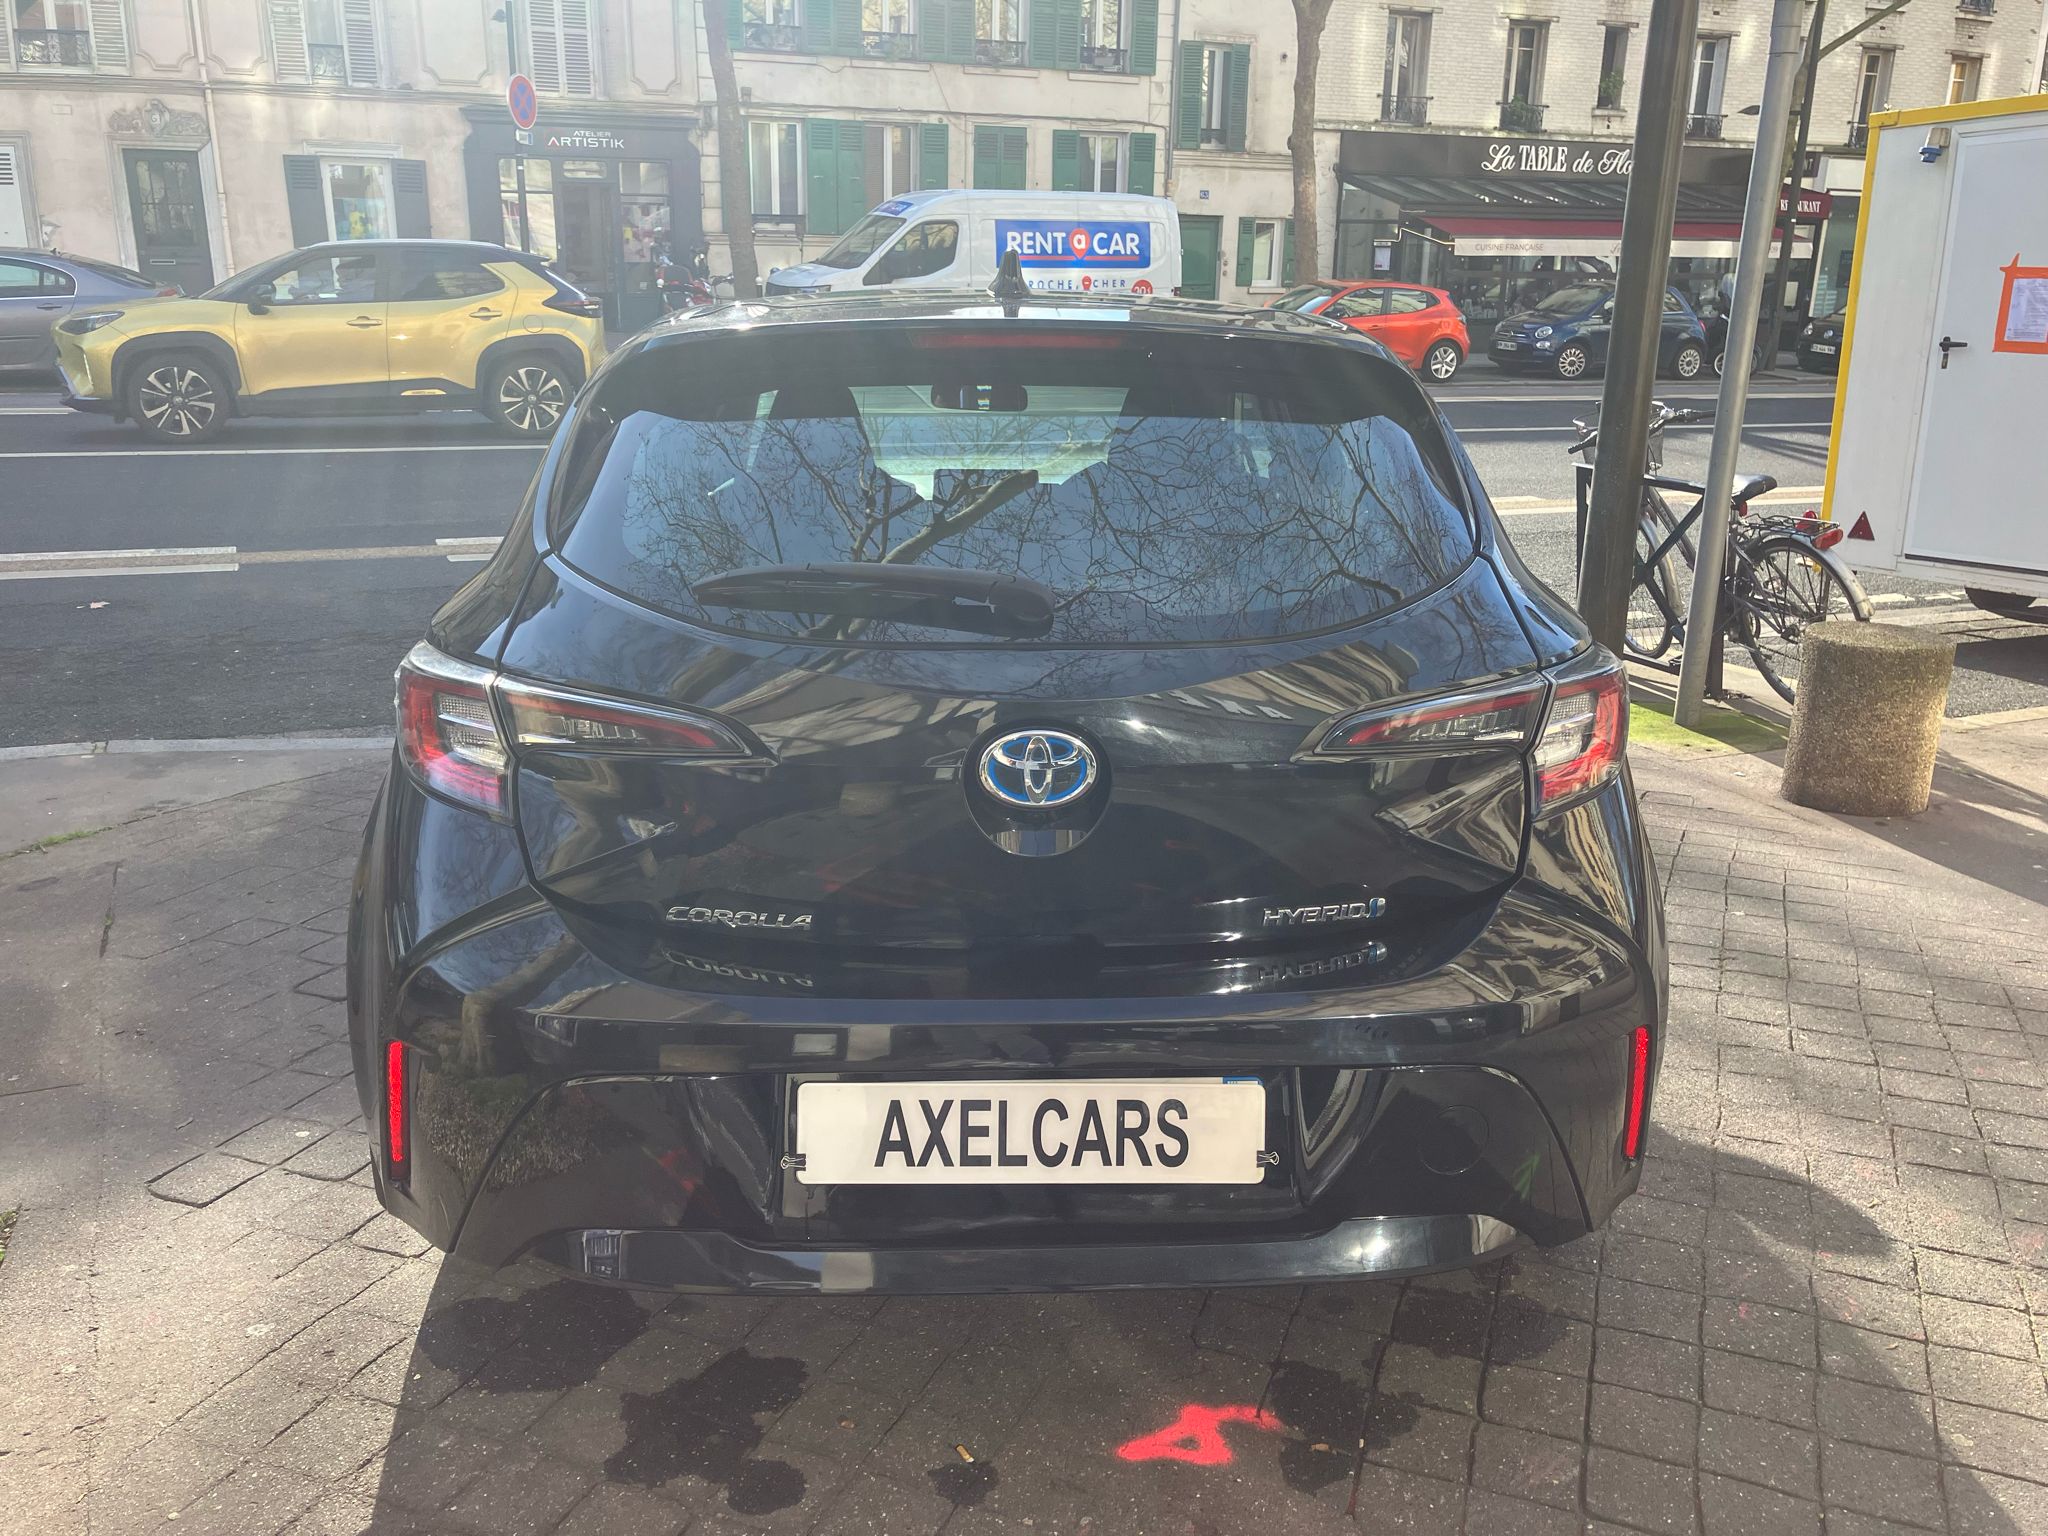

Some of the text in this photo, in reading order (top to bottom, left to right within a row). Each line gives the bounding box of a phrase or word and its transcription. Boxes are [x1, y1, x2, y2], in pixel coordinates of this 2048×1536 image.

[548, 137, 624, 149] ARTISTIK
[573, 130, 611, 138] ATELIER
[1481, 144, 1516, 172] La
[1519, 145, 1568, 172] TABLE
[1572, 150, 1594, 173] de
[1780, 199, 1821, 213] REURANT
[1006, 231, 1140, 255] RENT a CAR
[1475, 243, 1545, 252] CUISINE FRANÇAISE
[665, 906, 813, 930] COROLLA
[1263, 902, 1366, 927] HYBRID
[873, 1098, 1190, 1168] AXELCARS
